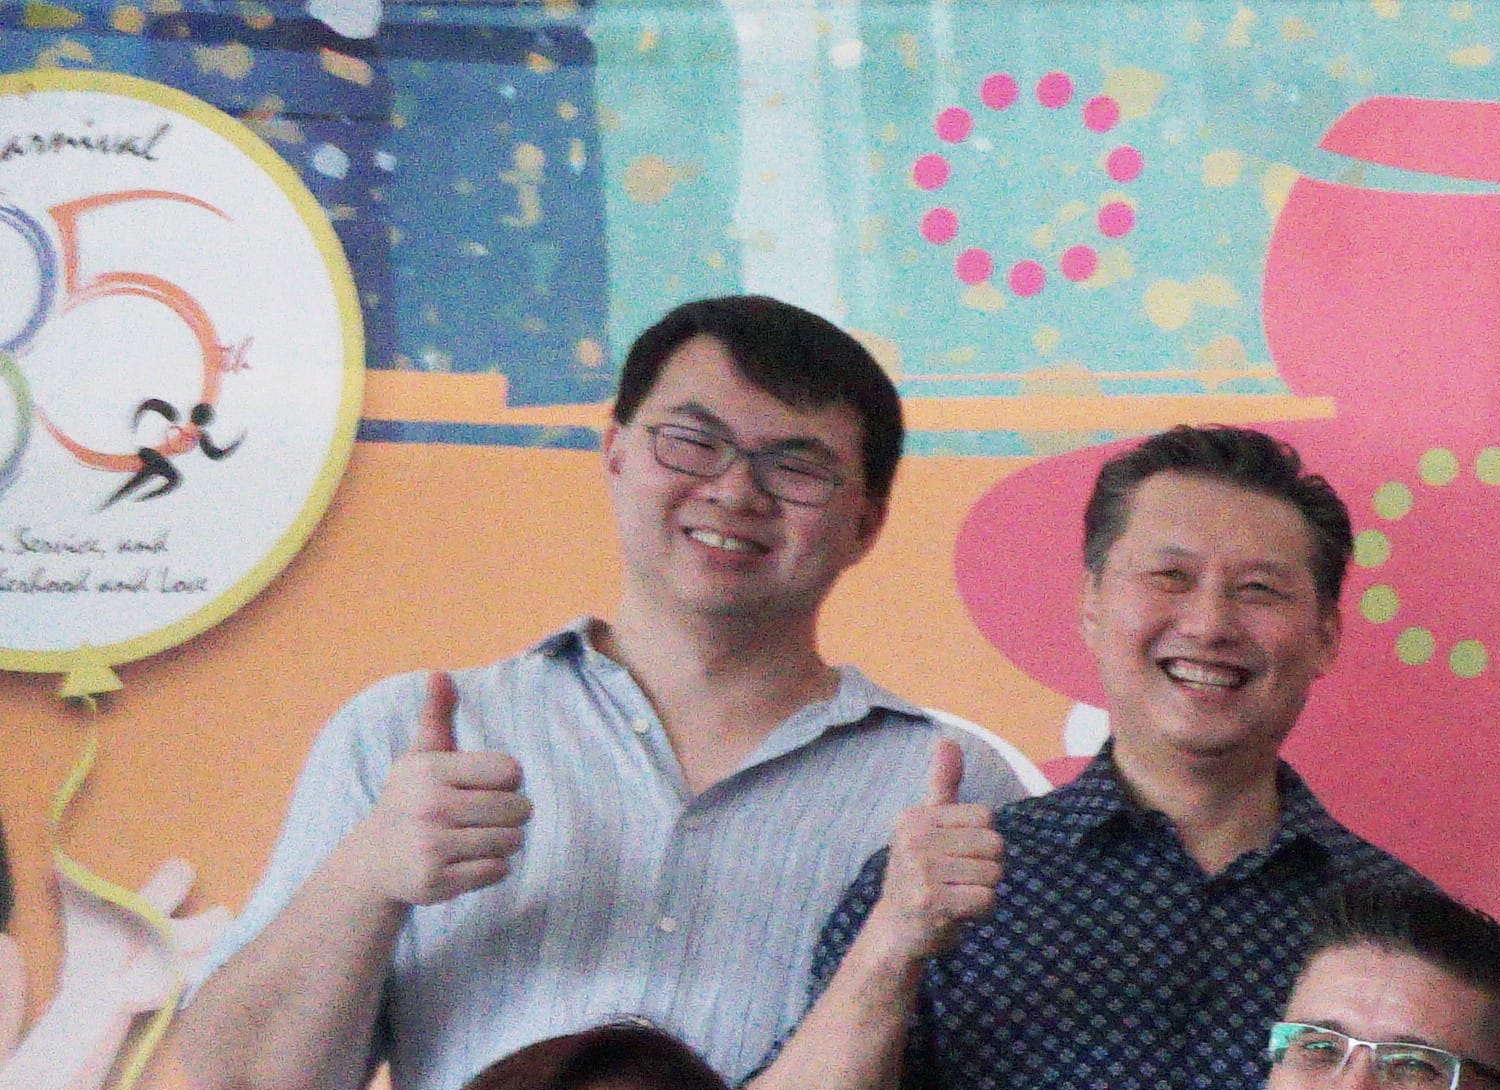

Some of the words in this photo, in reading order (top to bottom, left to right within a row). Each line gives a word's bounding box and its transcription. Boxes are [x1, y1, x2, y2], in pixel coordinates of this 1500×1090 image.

[0, 124, 172, 162] arnival
[118, 528, 172, 553] and
[0, 567, 92, 593] erhood
[97, 567, 151, 593] and
[161, 566, 208, 593] Love
